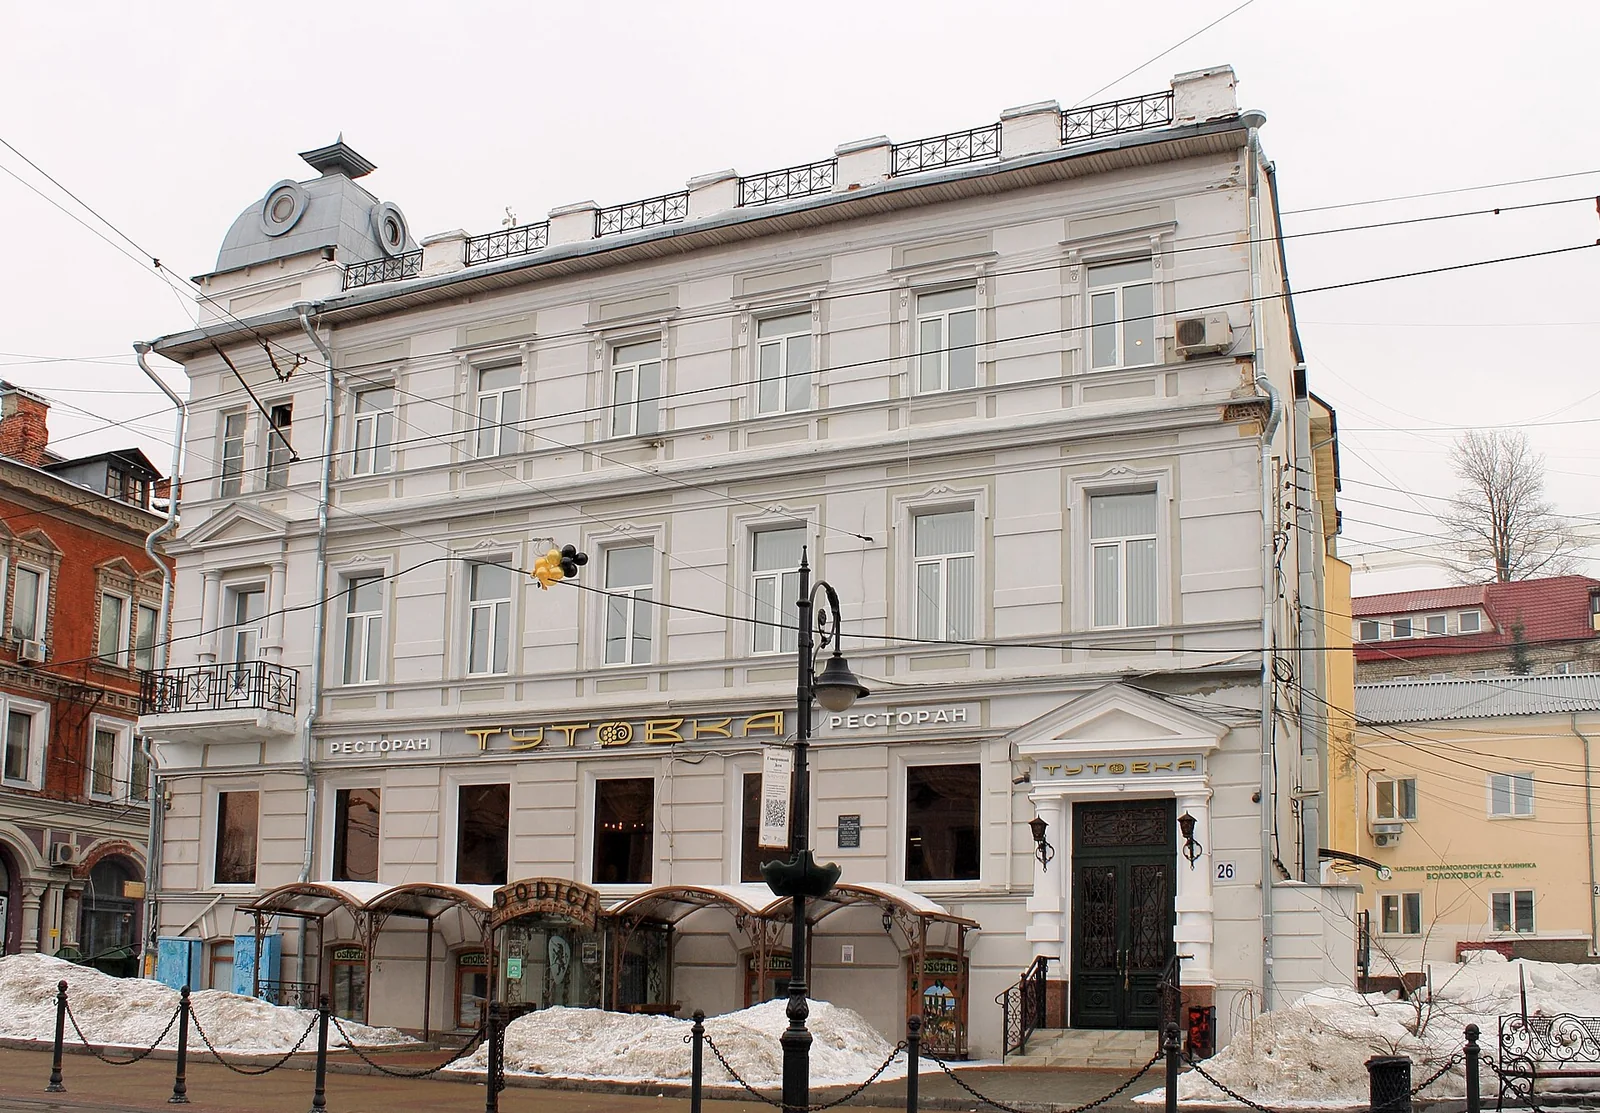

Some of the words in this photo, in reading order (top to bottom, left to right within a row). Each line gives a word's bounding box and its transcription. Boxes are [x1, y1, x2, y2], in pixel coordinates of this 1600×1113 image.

[829, 707, 968, 729] РЕСТОРАН
[465, 710, 785, 751] ТУТОВКА
[330, 737, 430, 754] РЕСТОРАН
[1042, 758, 1197, 776] ТУТОВКА
[1217, 863, 1234, 879] 26
[1425, 863, 1502, 872] СТОМАТОЛОГИЧЕСКАЯ
[1503, 862, 1537, 870] КЛИНИКА
[1426, 870, 1483, 880] ВОЛОХОВОЙ
[495, 881, 592, 911] DODICI
